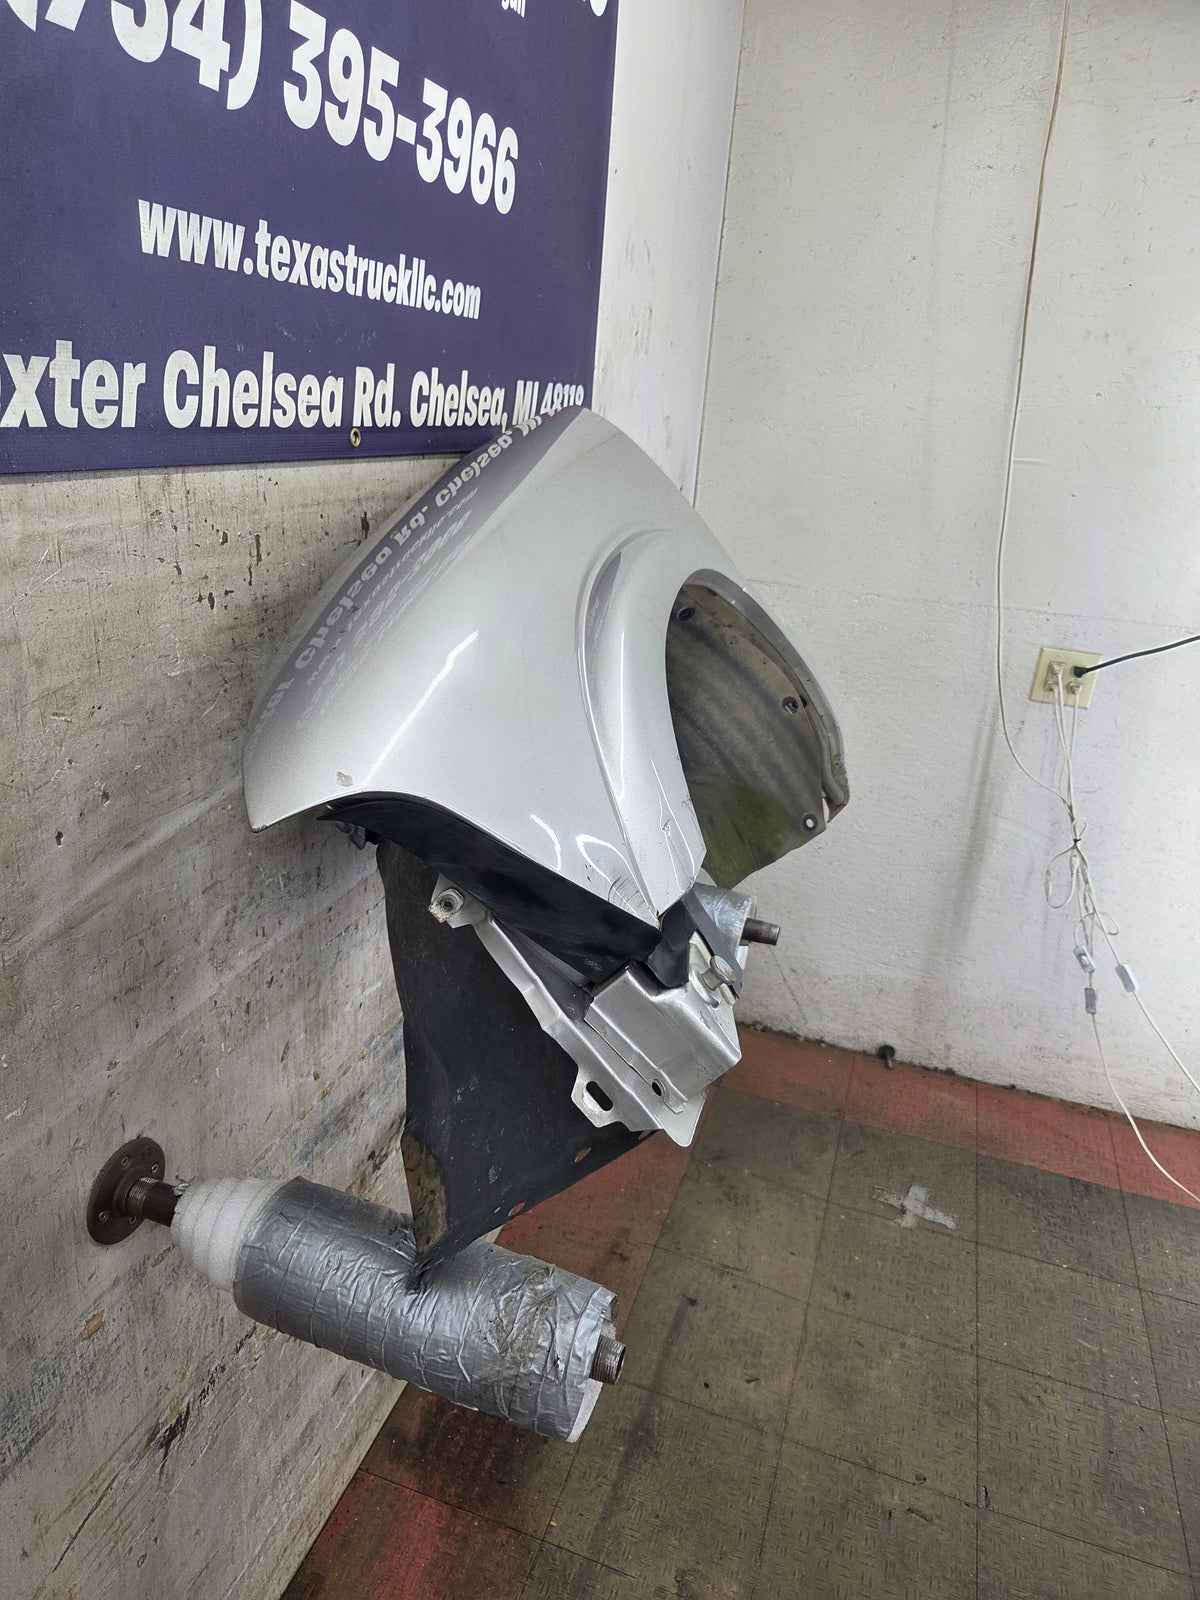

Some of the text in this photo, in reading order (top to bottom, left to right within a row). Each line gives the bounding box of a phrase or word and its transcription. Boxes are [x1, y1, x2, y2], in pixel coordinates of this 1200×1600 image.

[284, 0, 519, 214] 395-3966
[138, 199, 481, 319] www.texastruckllc.com
[0, 340, 146, 428] xter
[164, 346, 343, 428] Chelsea
[353, 363, 400, 428] Rd.
[410, 367, 508, 434] Chelsea,
